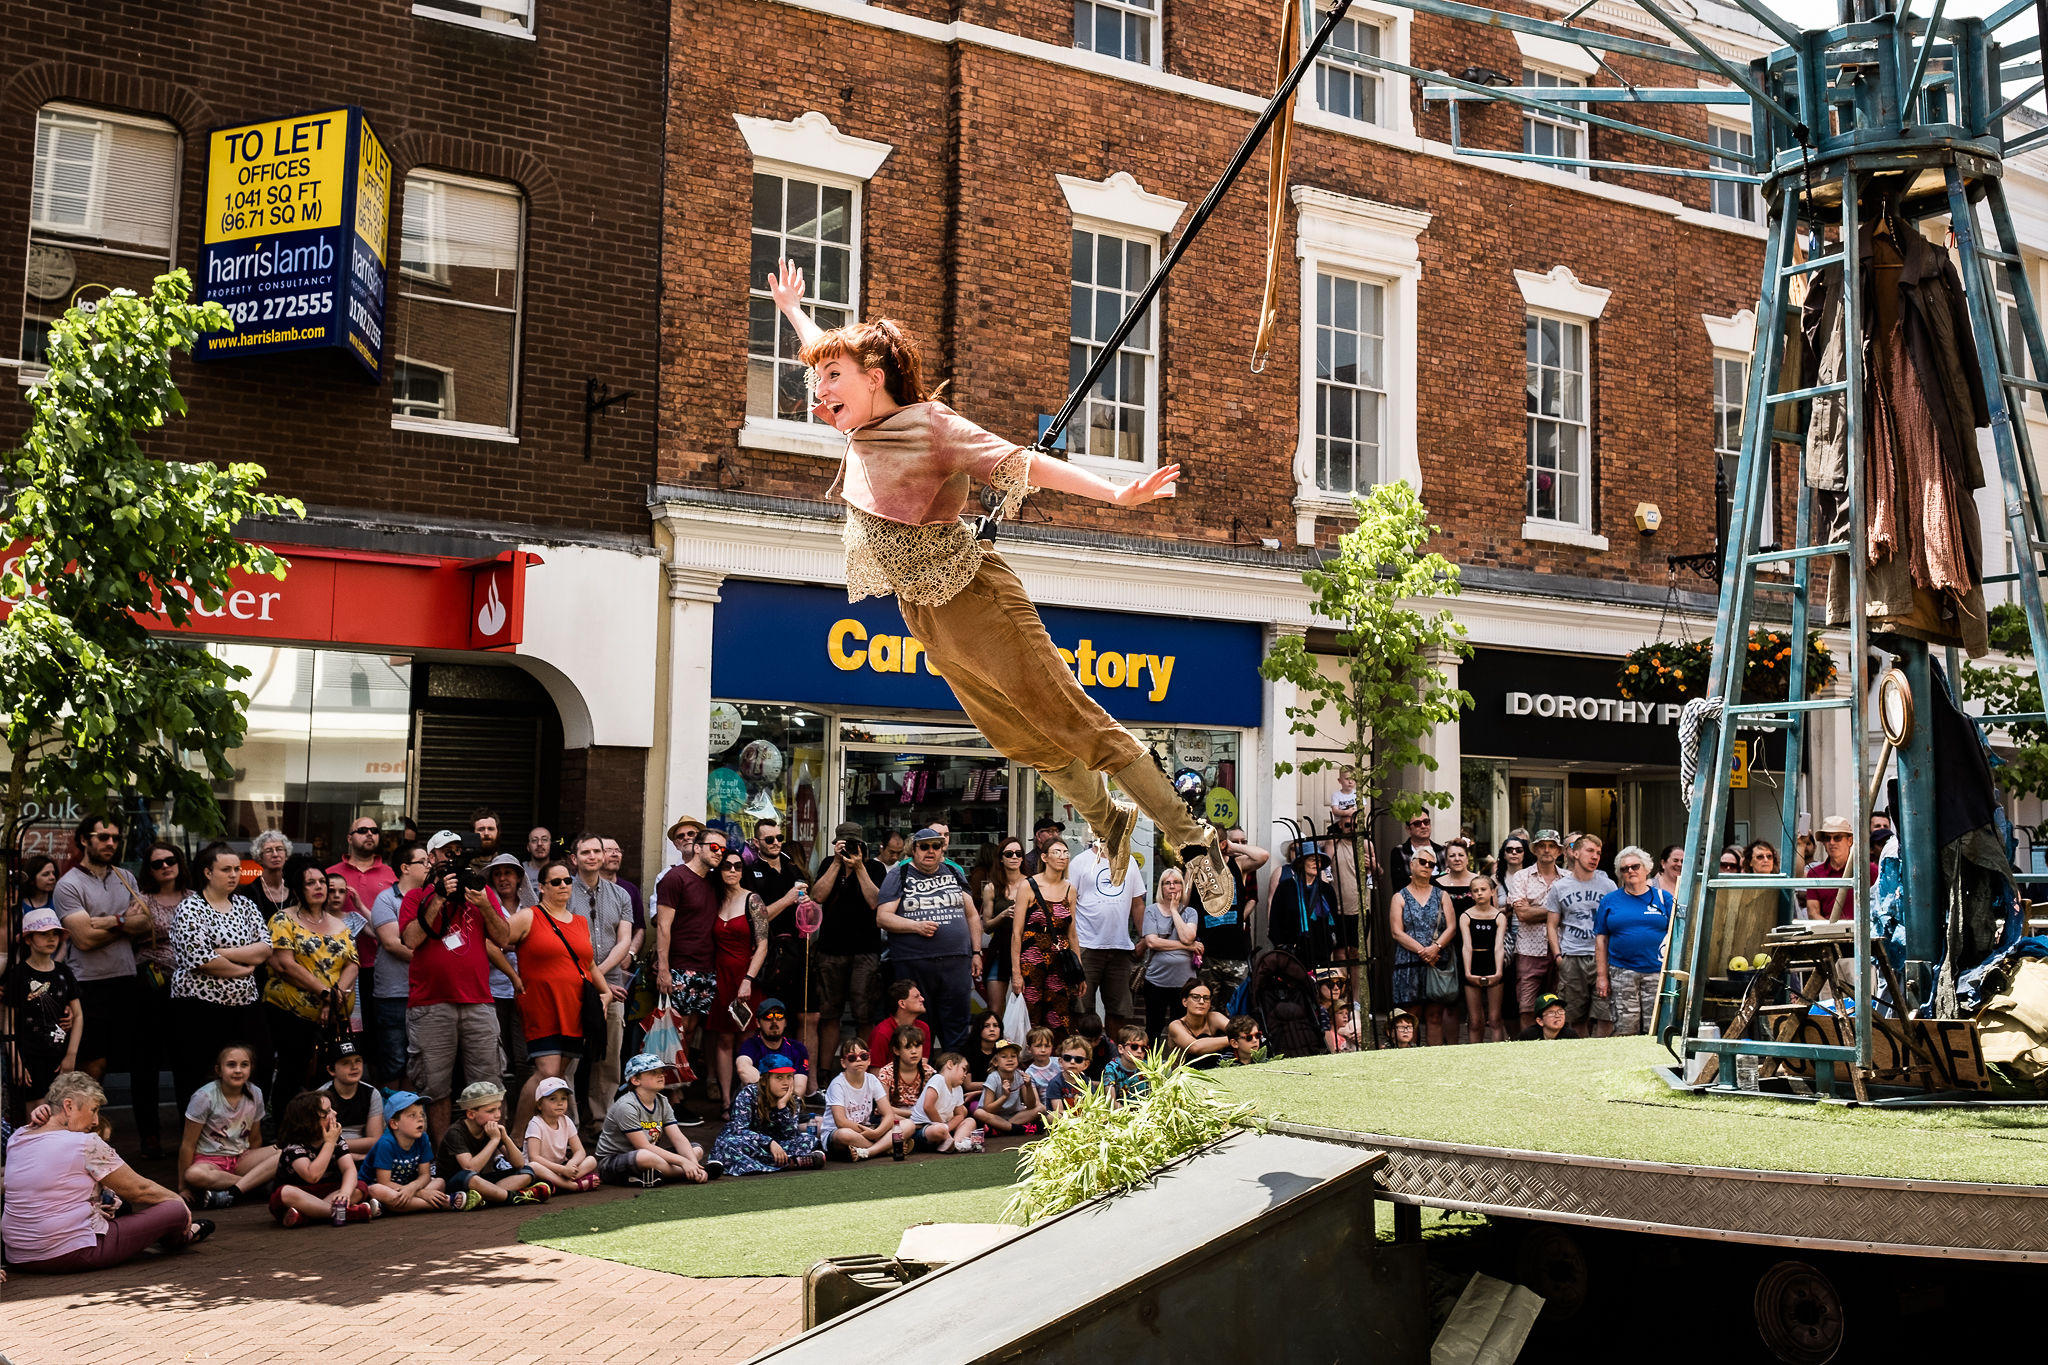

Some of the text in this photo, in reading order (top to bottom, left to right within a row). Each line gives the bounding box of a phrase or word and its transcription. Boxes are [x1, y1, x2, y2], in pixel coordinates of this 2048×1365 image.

[225, 119, 331, 163] TO LET
[363, 124, 388, 189] TO LET
[238, 158, 310, 185] OFFICES
[225, 181, 321, 212] 1,041 SQ FT
[222, 199, 322, 234] (96.71 SQ M)
[208, 235, 334, 283] harrislamb
[208, 275, 332, 298] PROPERTY CONSULTANCY
[226, 301, 258, 324] 782
[263, 291, 333, 320] 272555
[208, 326, 325, 350] www.harrislamb.com
[1506, 692, 1656, 724] DOROTHY
[1213, 803, 1233, 819] 29p
[27, 831, 54, 854] 21
[800, 823, 814, 838] SALE
[1561, 890, 1582, 907] IT'S
